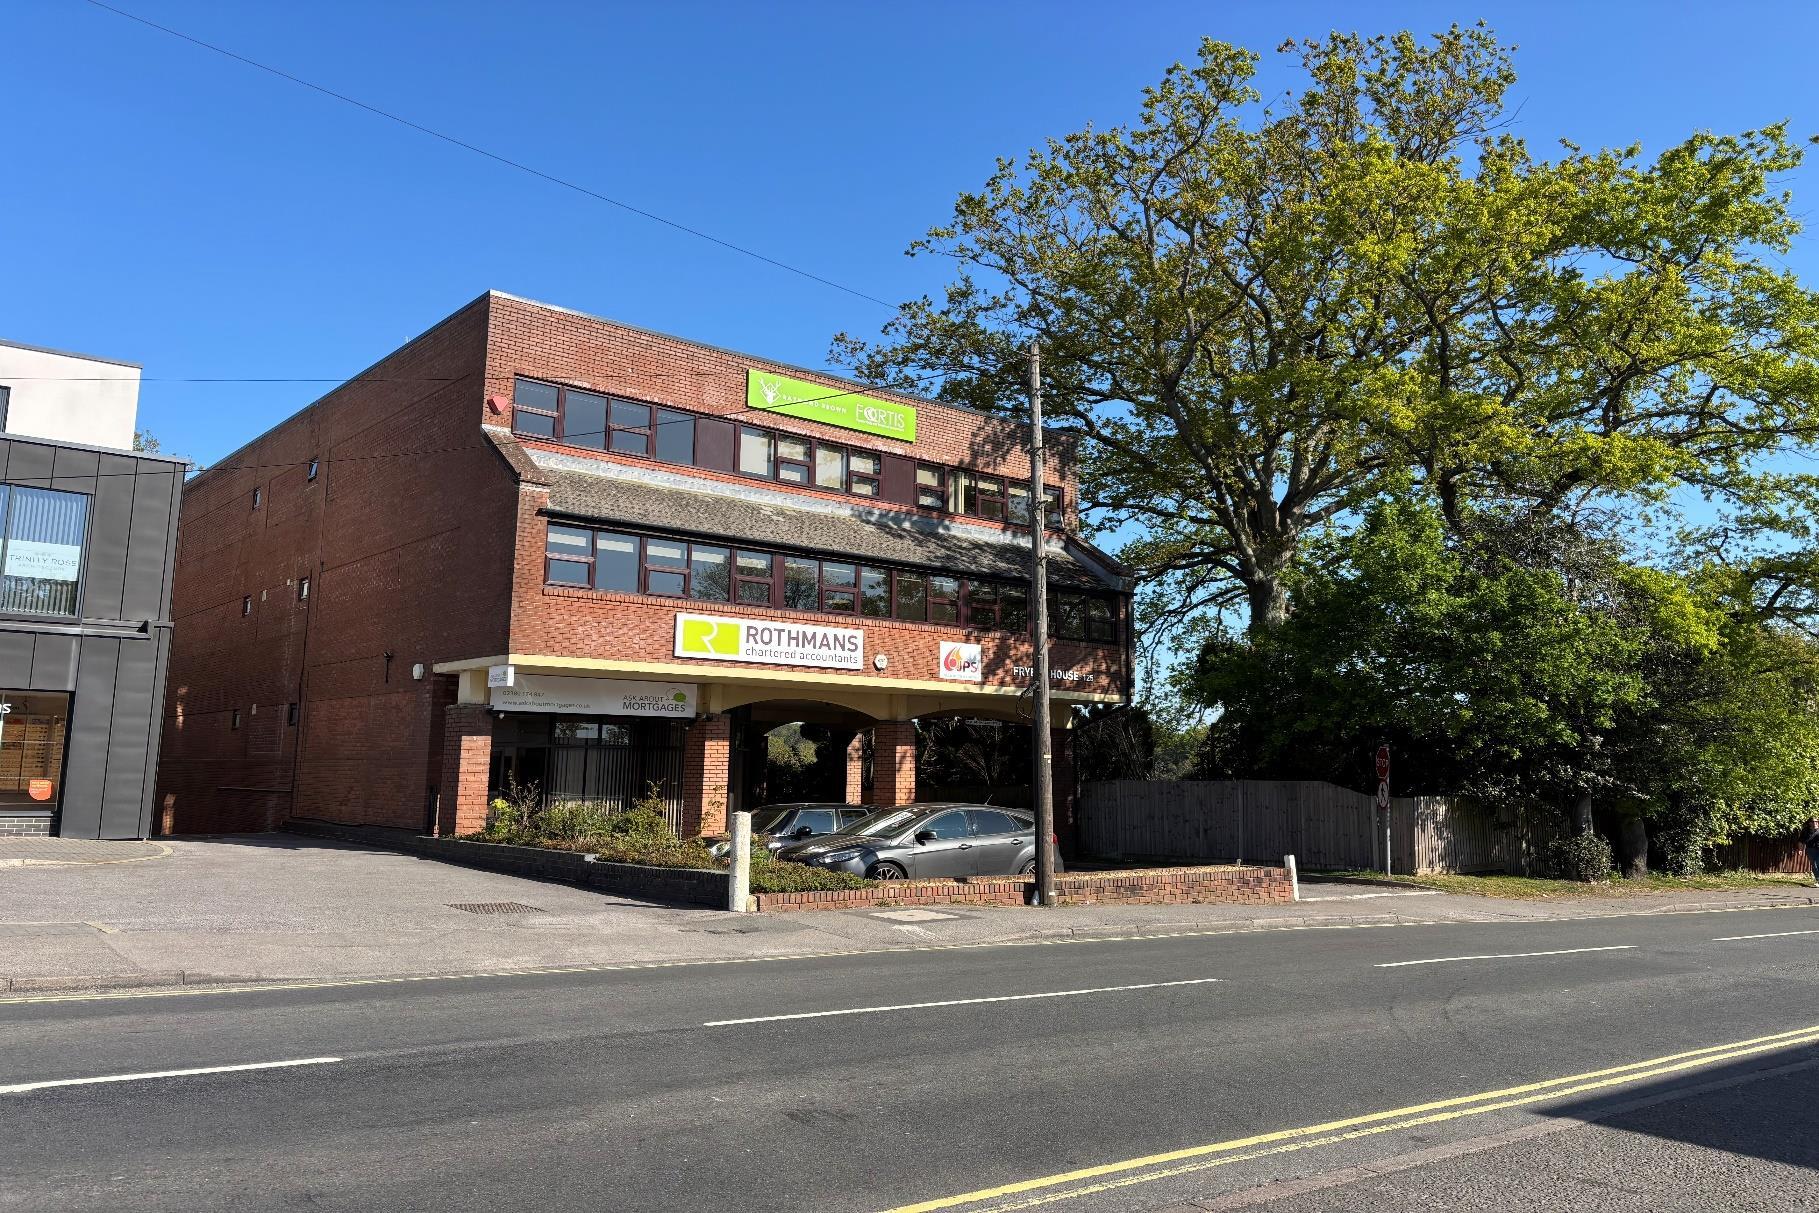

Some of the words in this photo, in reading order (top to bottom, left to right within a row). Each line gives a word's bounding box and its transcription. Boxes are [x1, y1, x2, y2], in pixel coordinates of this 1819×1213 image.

[856, 403, 905, 428] FORTIS
[9, 554, 48, 564] TRINITY
[745, 625, 859, 653] ROTHMANS
[745, 647, 797, 659] chartered
[799, 651, 858, 664] accountants
[957, 660, 979, 673] JPS
[1050, 670, 1079, 681] HOUSE
[622, 701, 686, 712] MORTGAGES
